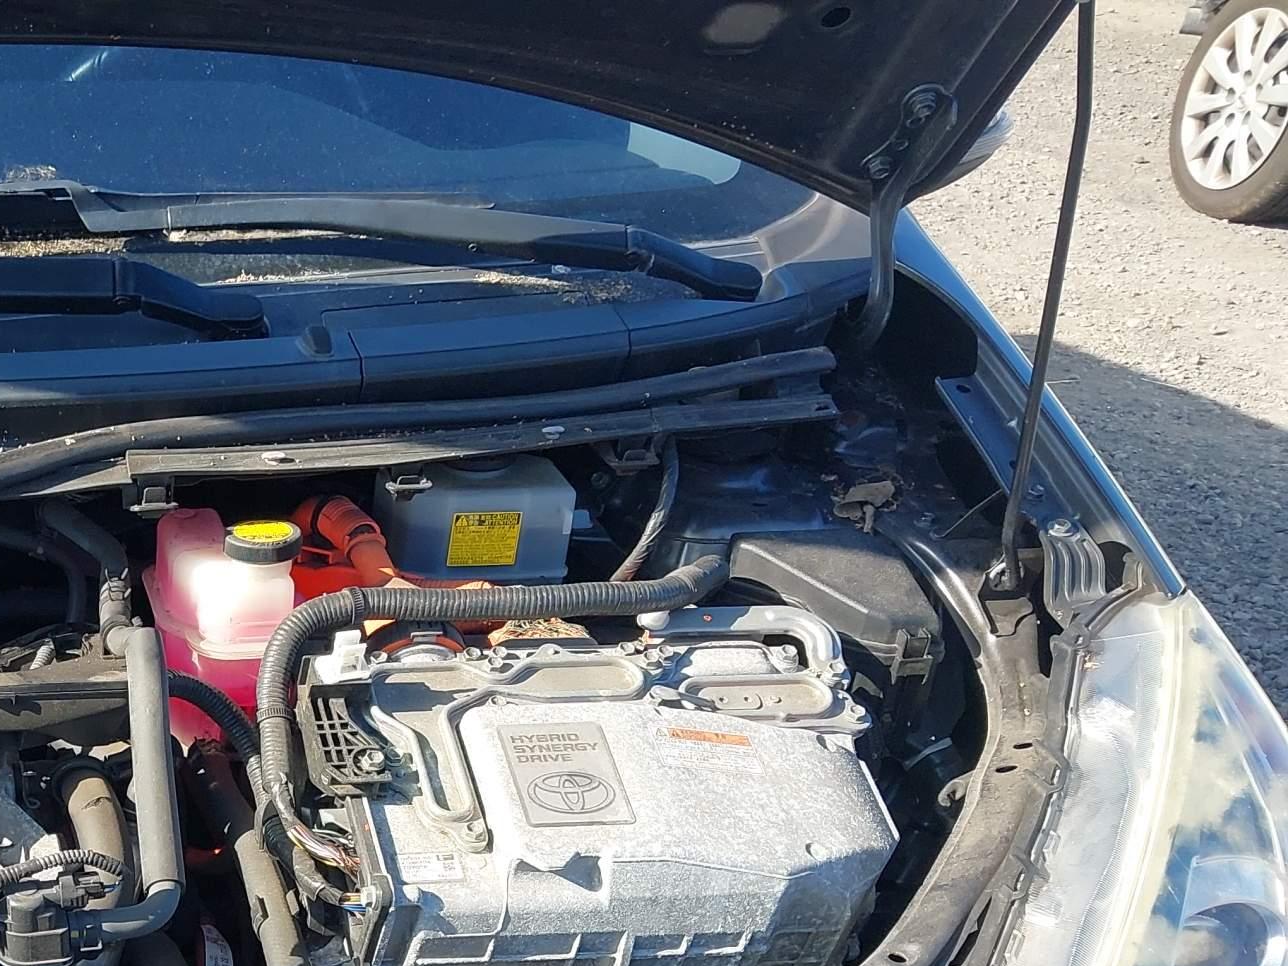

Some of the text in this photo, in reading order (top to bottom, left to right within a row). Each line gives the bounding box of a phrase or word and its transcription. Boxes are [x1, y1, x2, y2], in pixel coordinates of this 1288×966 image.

[510, 733, 580, 744] HYBRID
[513, 742, 599, 754] SYNERGY
[517, 753, 574, 763] DRIVE
